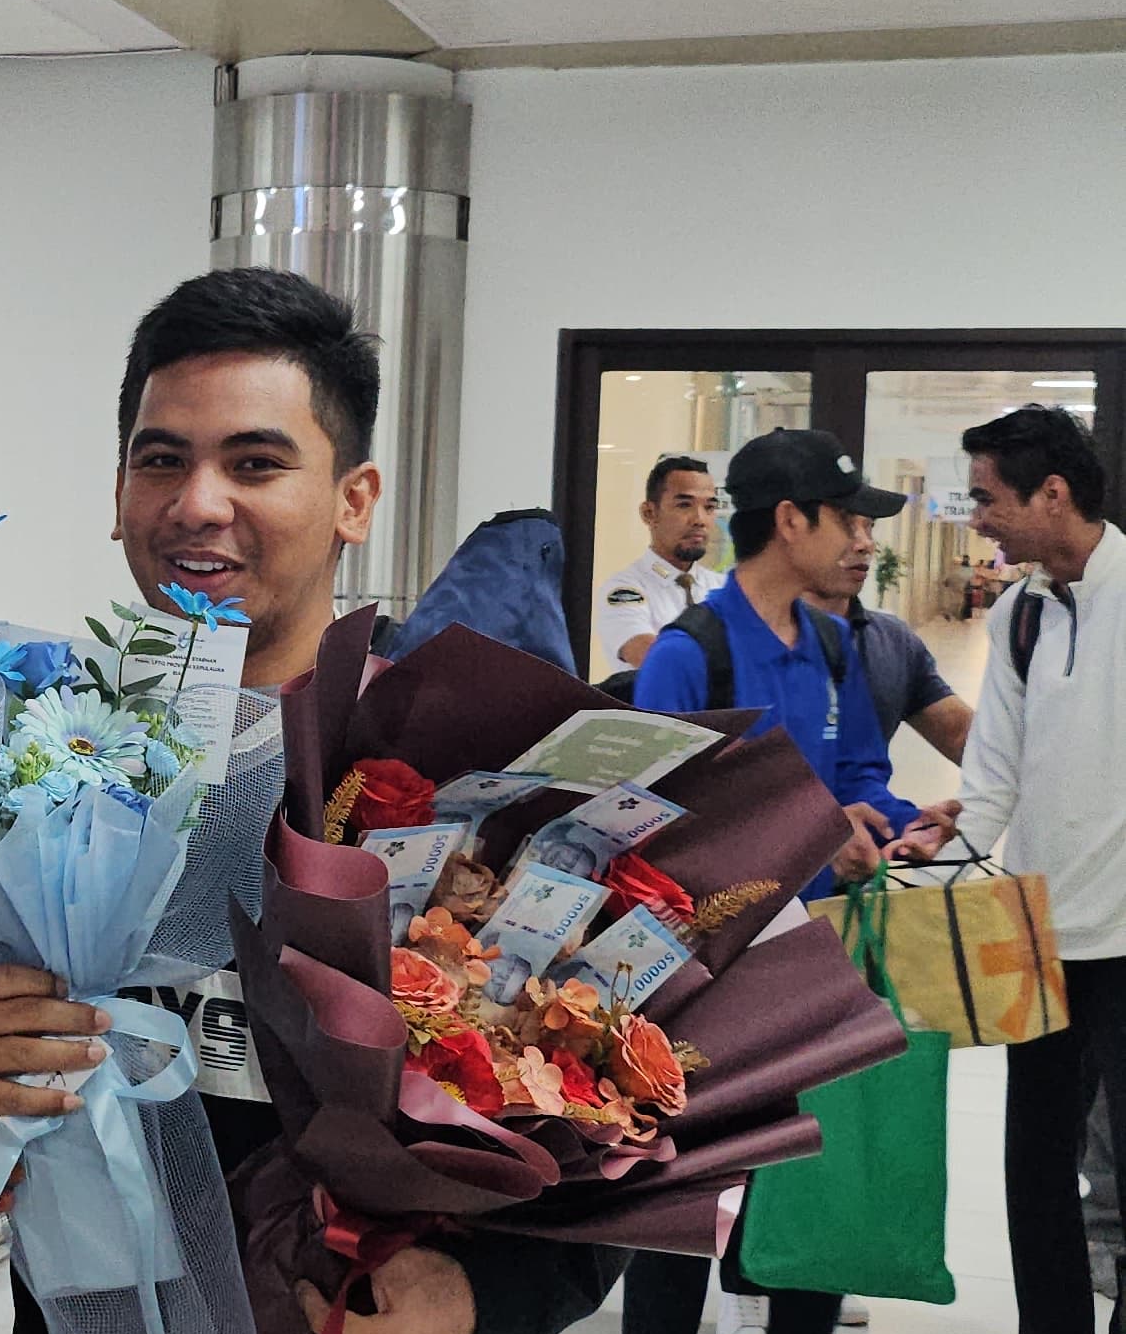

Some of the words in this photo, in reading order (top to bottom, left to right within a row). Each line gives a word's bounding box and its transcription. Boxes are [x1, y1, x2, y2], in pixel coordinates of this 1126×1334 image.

[626, 810, 671, 840] 50000
[422, 834, 449, 873] 50000
[554, 893, 591, 937] 50000
[634, 951, 675, 992] 50000
